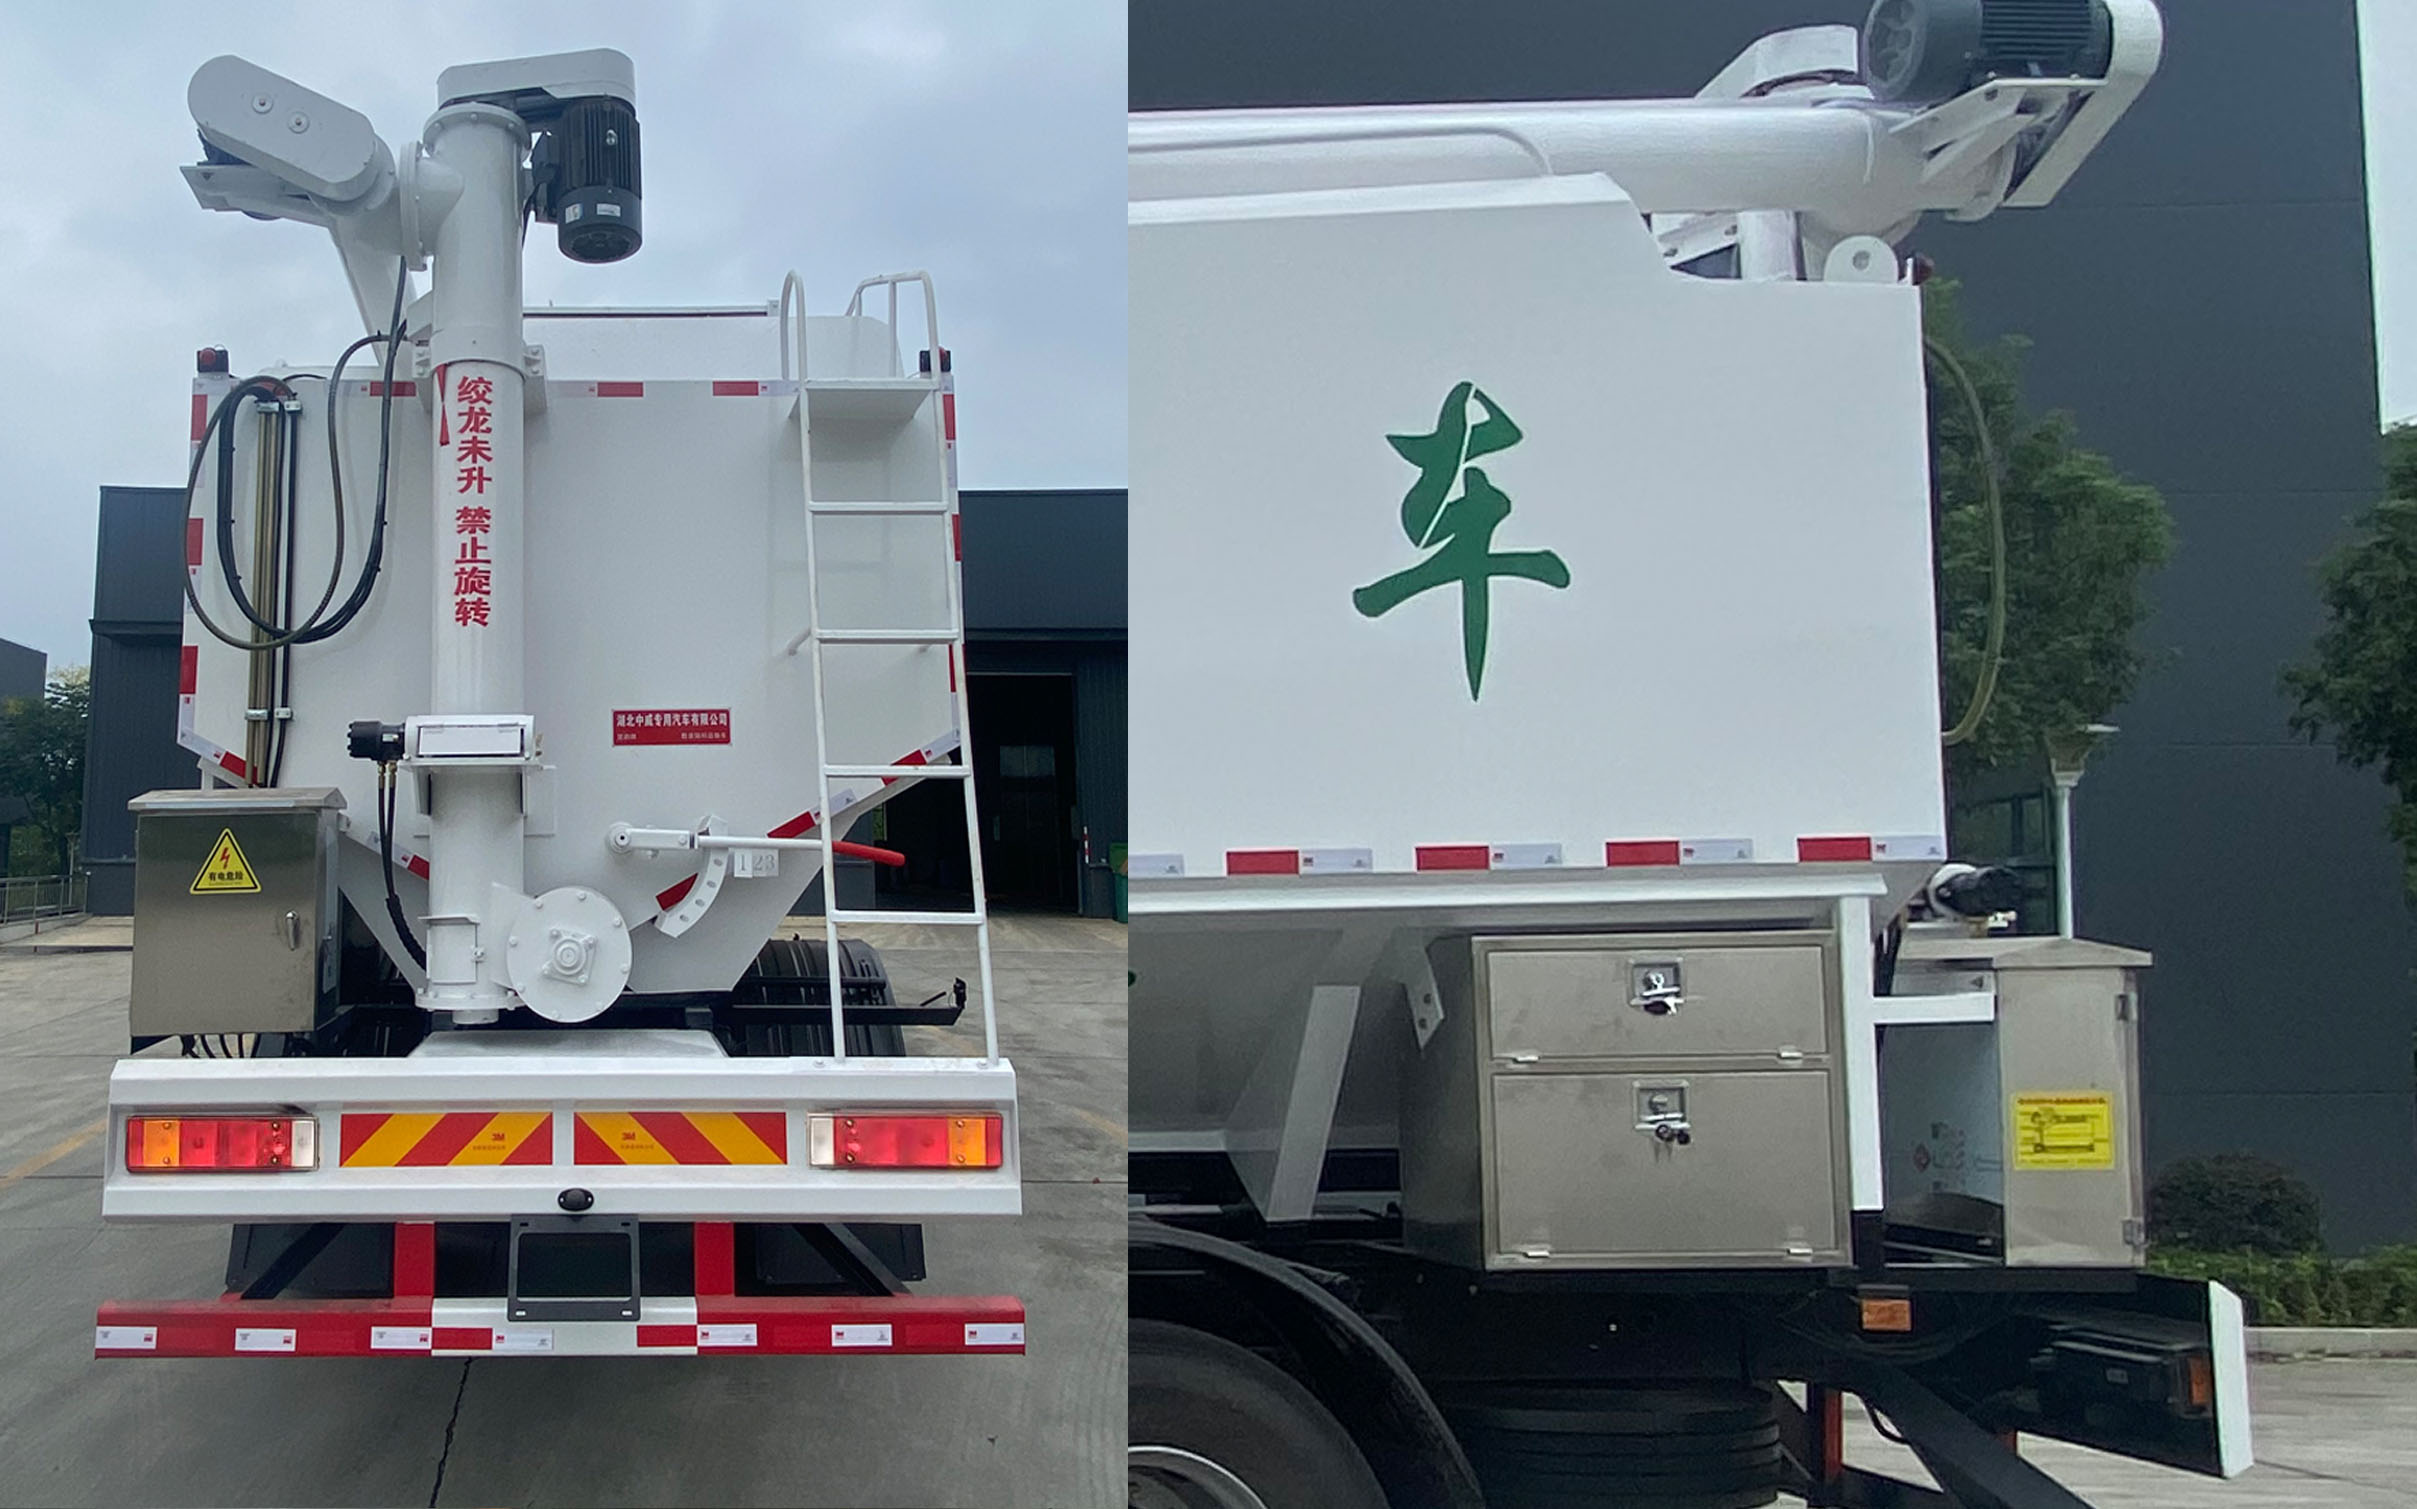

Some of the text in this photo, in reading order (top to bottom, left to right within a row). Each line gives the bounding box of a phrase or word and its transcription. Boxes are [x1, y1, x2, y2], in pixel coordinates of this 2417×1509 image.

[454, 376, 493, 627] 绞龙未升 禁止旋转
[1352, 380, 1571, 702] 车
[208, 871, 244, 881] 有电危险
